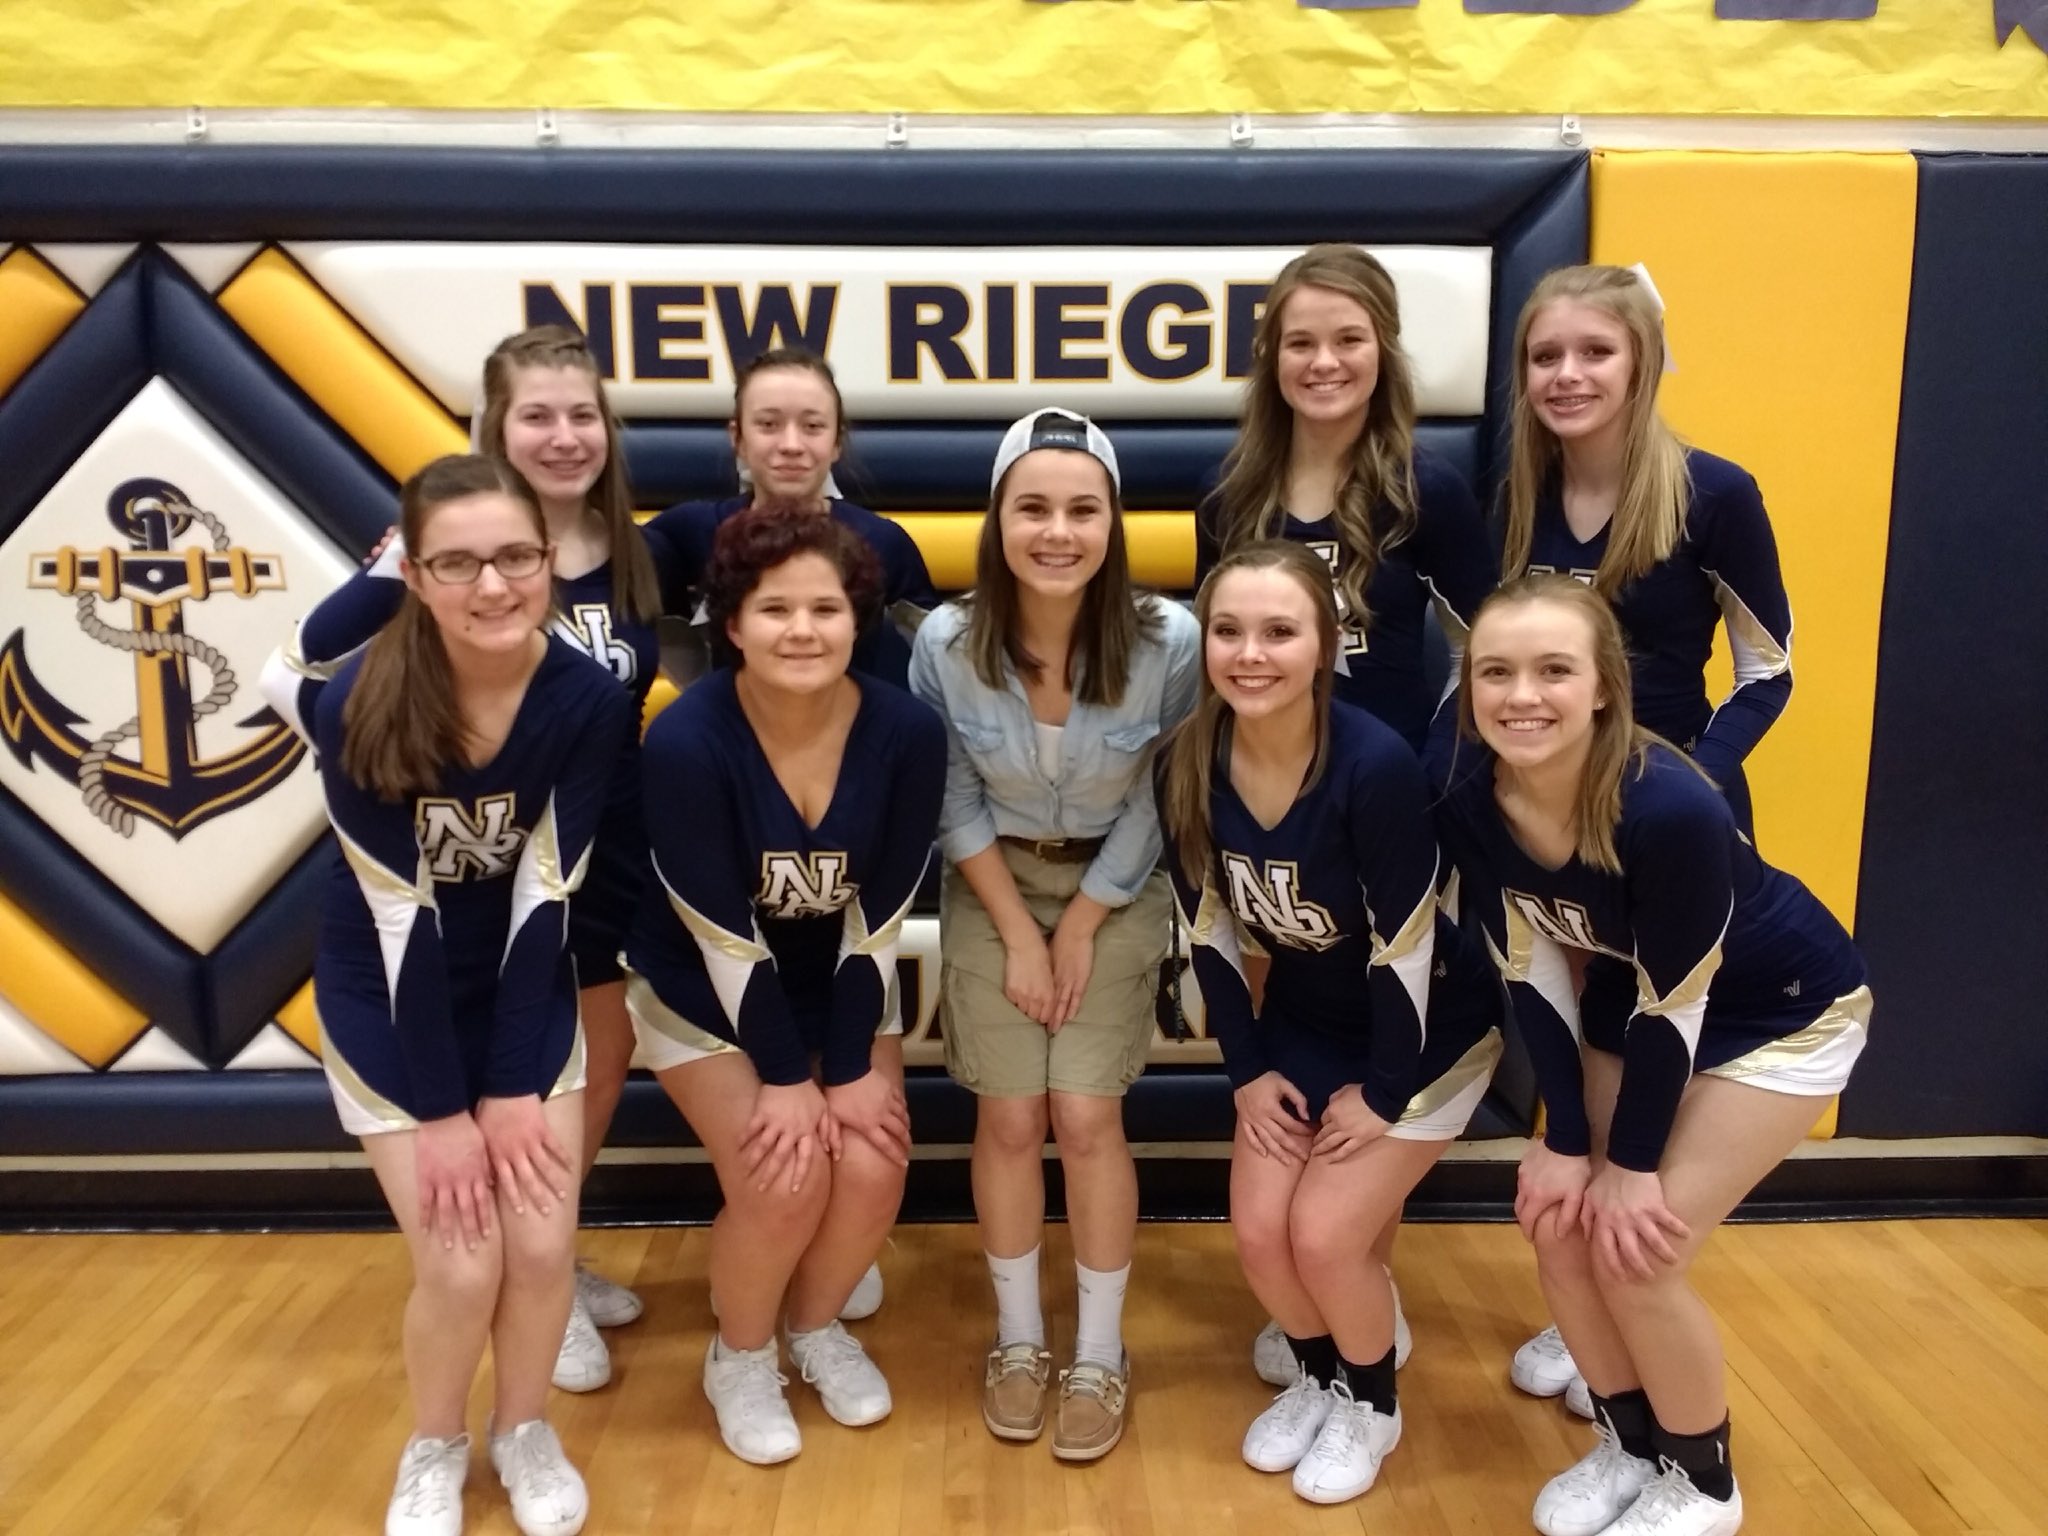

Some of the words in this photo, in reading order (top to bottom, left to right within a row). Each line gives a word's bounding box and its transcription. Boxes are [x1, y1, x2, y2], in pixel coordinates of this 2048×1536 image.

[521, 281, 840, 384] NEW
[887, 279, 1279, 384] RIEGE
[1506, 887, 1612, 954] N
